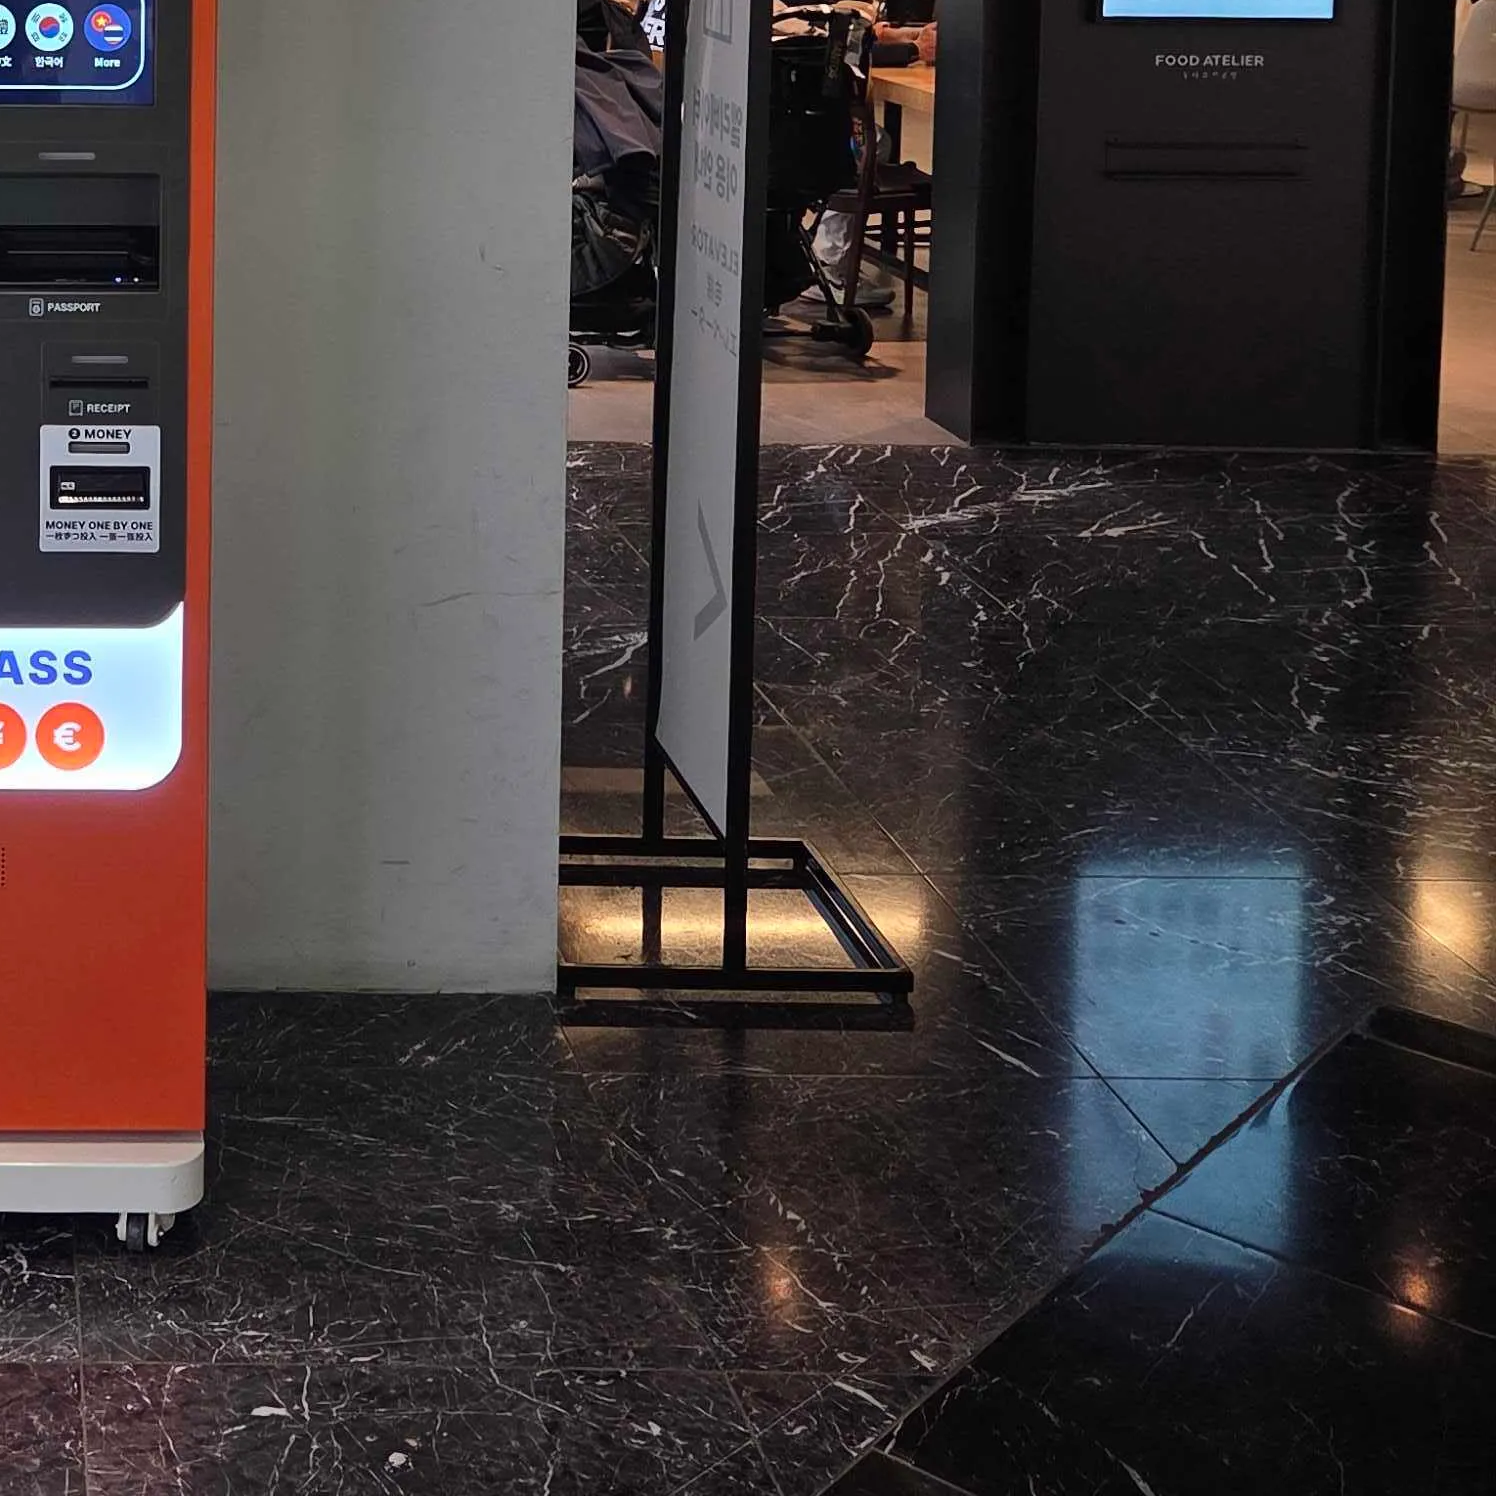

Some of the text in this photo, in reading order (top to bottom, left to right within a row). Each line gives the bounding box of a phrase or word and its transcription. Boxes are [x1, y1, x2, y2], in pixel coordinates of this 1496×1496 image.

[35, 56, 64, 68] 한국어
[94, 57, 121, 68] More
[1155, 55, 1264, 67] FOOD ATELIER
[47, 303, 101, 313] PASSPORT
[86, 403, 131, 413] RECEIPT
[84, 429, 132, 439] MONEY
[45, 520, 153, 531] MONEY ONE BY ONE
